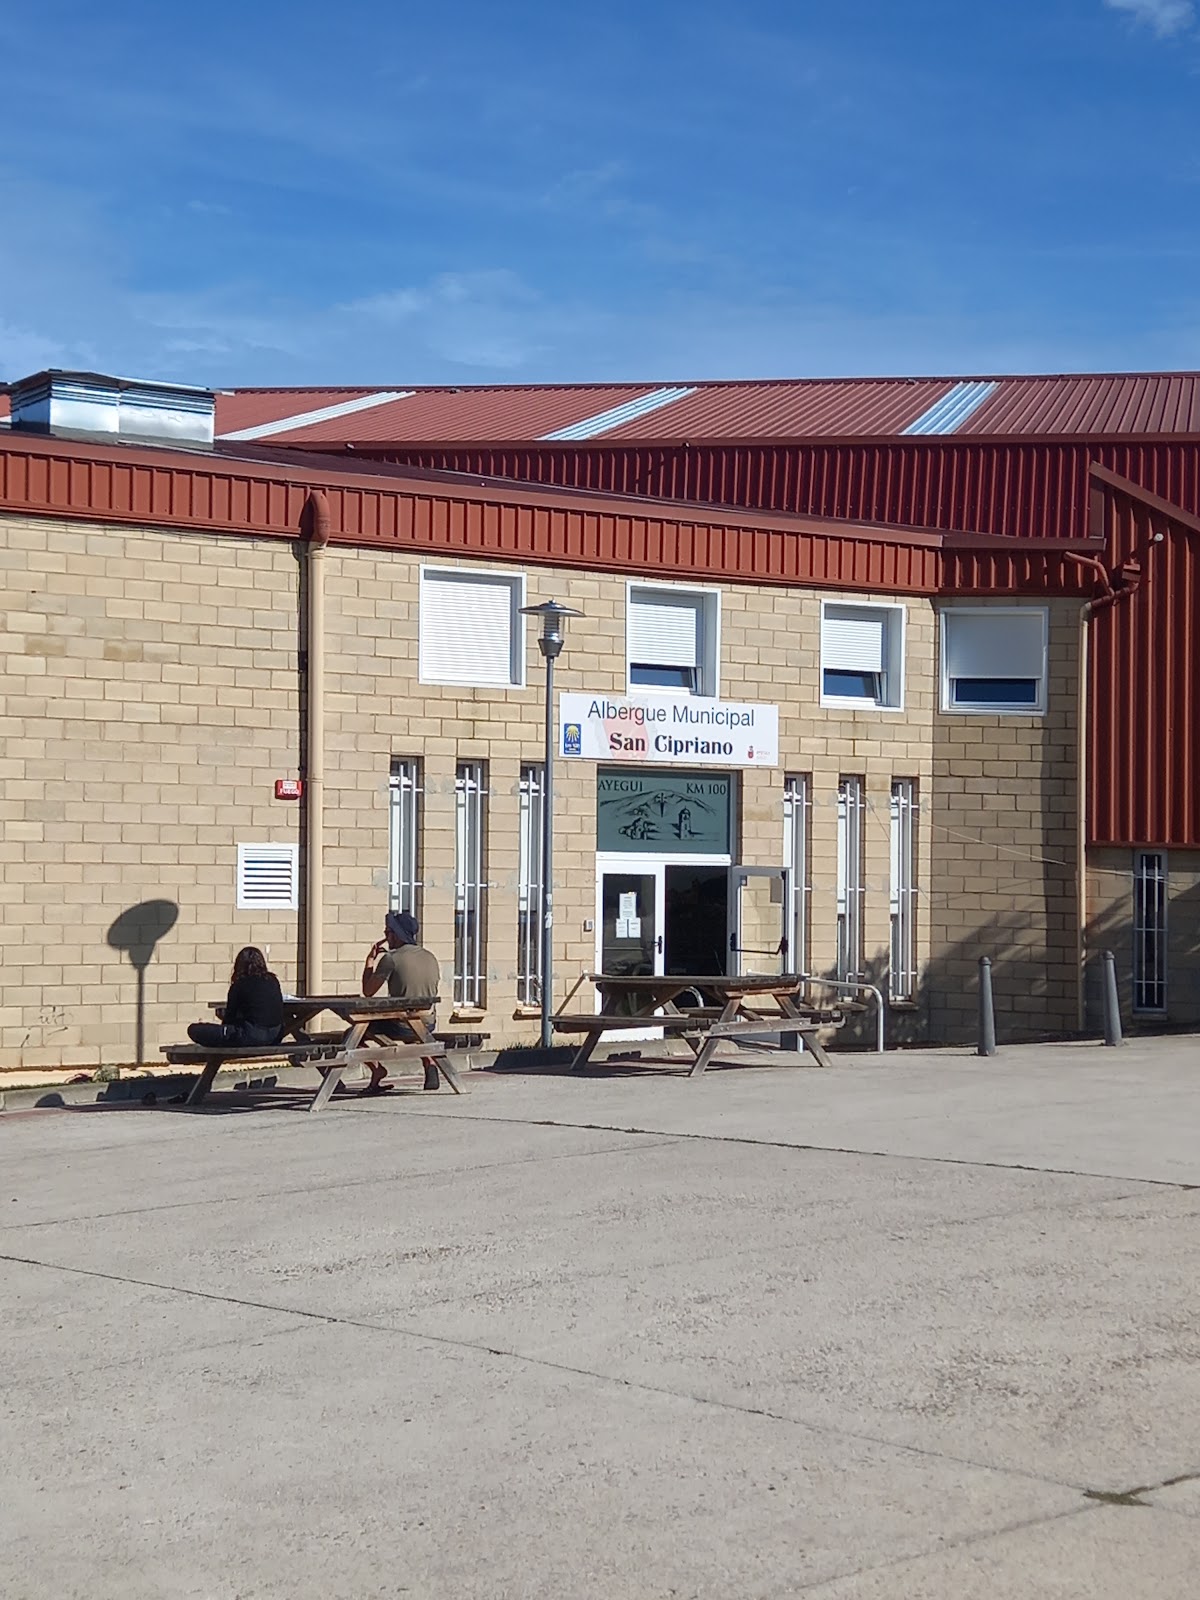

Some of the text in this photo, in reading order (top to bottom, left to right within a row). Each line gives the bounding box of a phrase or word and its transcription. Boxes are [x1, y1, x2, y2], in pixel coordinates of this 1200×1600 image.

[587, 700, 754, 730] Albergue Municipal
[609, 732, 646, 751] San
[654, 734, 733, 756] Cipriano
[598, 780, 643, 792] AYEGUI
[686, 783, 726, 795] KM 100
